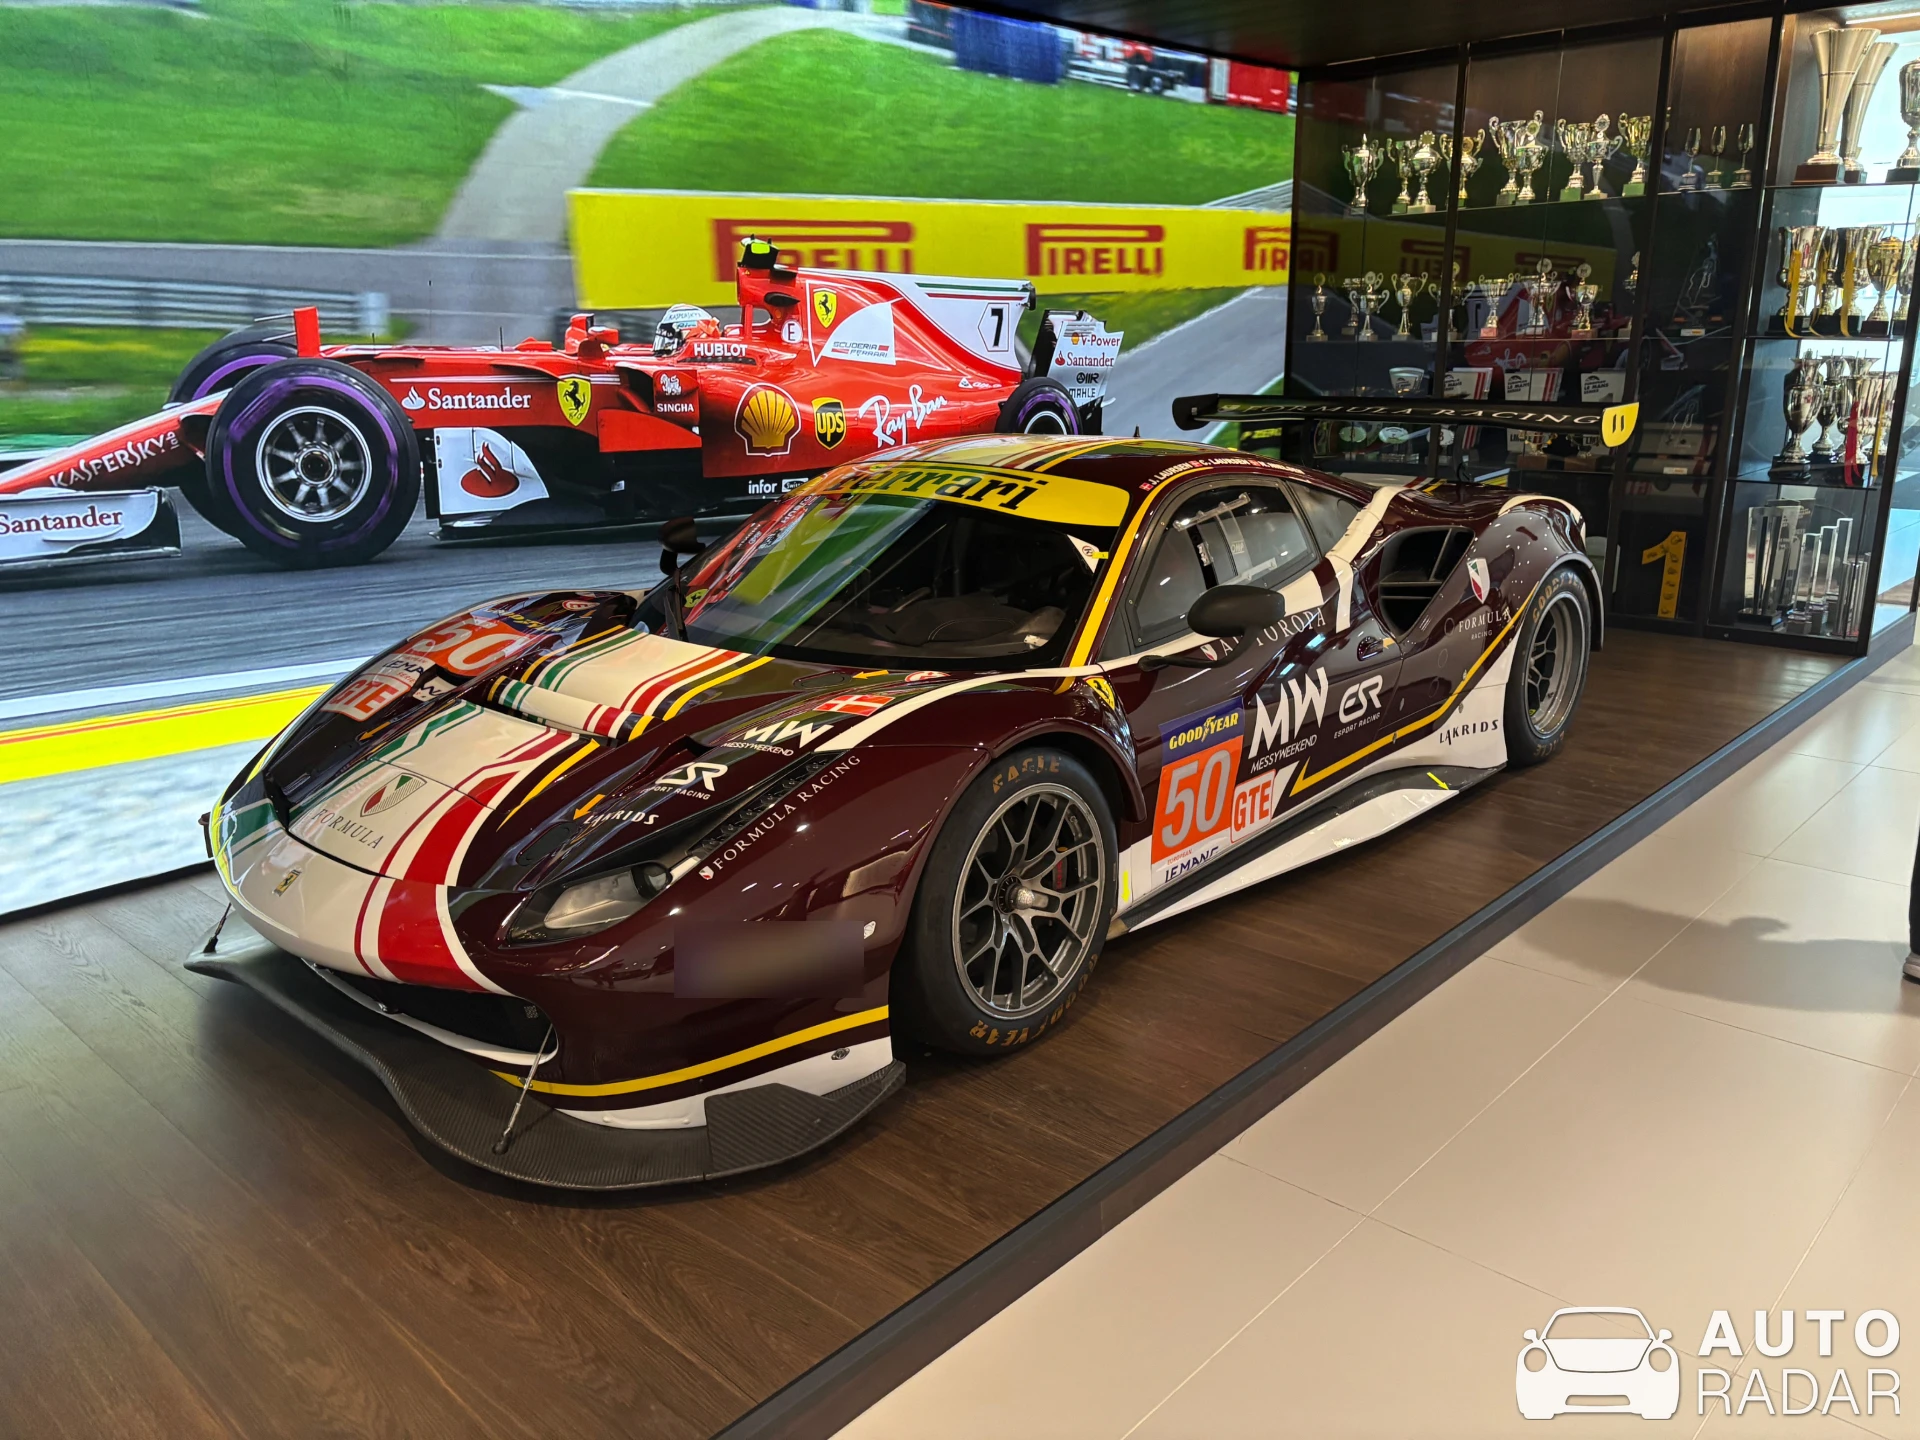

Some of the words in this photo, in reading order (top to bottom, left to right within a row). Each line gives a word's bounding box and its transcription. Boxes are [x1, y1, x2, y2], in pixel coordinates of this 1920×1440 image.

[1026, 223, 1164, 277] PIRELLI
[787, 323, 796, 341] E
[991, 308, 1004, 347] 7
[693, 343, 748, 357] HUBLOT
[833, 341, 878, 350] SCUDERIA
[1066, 351, 1115, 366] Santander
[428, 387, 532, 410] Santander
[1069, 387, 1096, 398] MAHLE
[656, 402, 695, 413] SINGHA
[1244, 403, 1413, 417] FORMULA
[1431, 408, 1600, 424] RACING
[49, 433, 166, 487] KASPERSKY
[1157, 461, 1194, 481] LAURSEN
[748, 478, 778, 494] infor
[0, 505, 123, 534] Santander
[1458, 607, 1512, 633] FORMULA
[1470, 629, 1493, 641] RACING
[1248, 667, 1329, 759] MW
[1334, 724, 1357, 739] ESPORT
[1358, 712, 1381, 729] RACING
[1439, 719, 1500, 746] LAKRIDS
[1250, 734, 1318, 774] MESSYWEEKEND
[675, 787, 711, 801] RACING
[1161, 749, 1231, 848] 50
[1233, 780, 1272, 832] GTE
[713, 803, 797, 871] FORMULA
[797, 754, 862, 803] RACING
[311, 808, 386, 850] FORMULA
